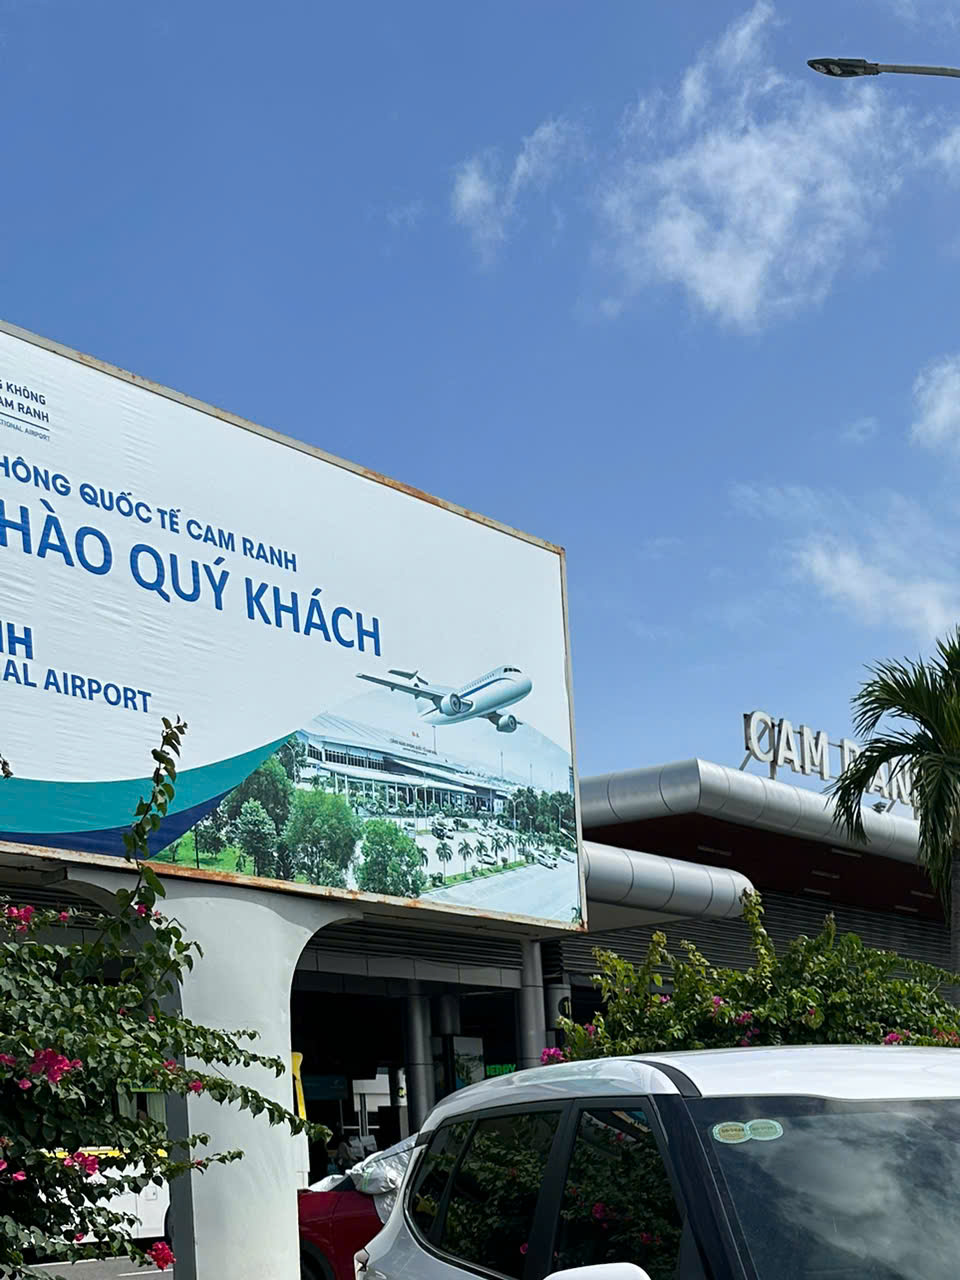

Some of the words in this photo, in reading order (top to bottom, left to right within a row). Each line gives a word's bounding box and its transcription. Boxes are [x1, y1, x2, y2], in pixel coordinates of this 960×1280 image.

[6, 381, 46, 405] KHÔNG
[17, 402, 49, 423] RANH
[79, 483, 152, 523] QUỐC
[157, 508, 181, 534] TẾ
[186, 519, 235, 552] CAM
[242, 536, 297, 572] RANH
[130, 543, 230, 611] QUÝ
[244, 577, 381, 657] KHÁCH
[43, 668, 152, 713] AIRPORT
[744, 710, 829, 781] CAM
